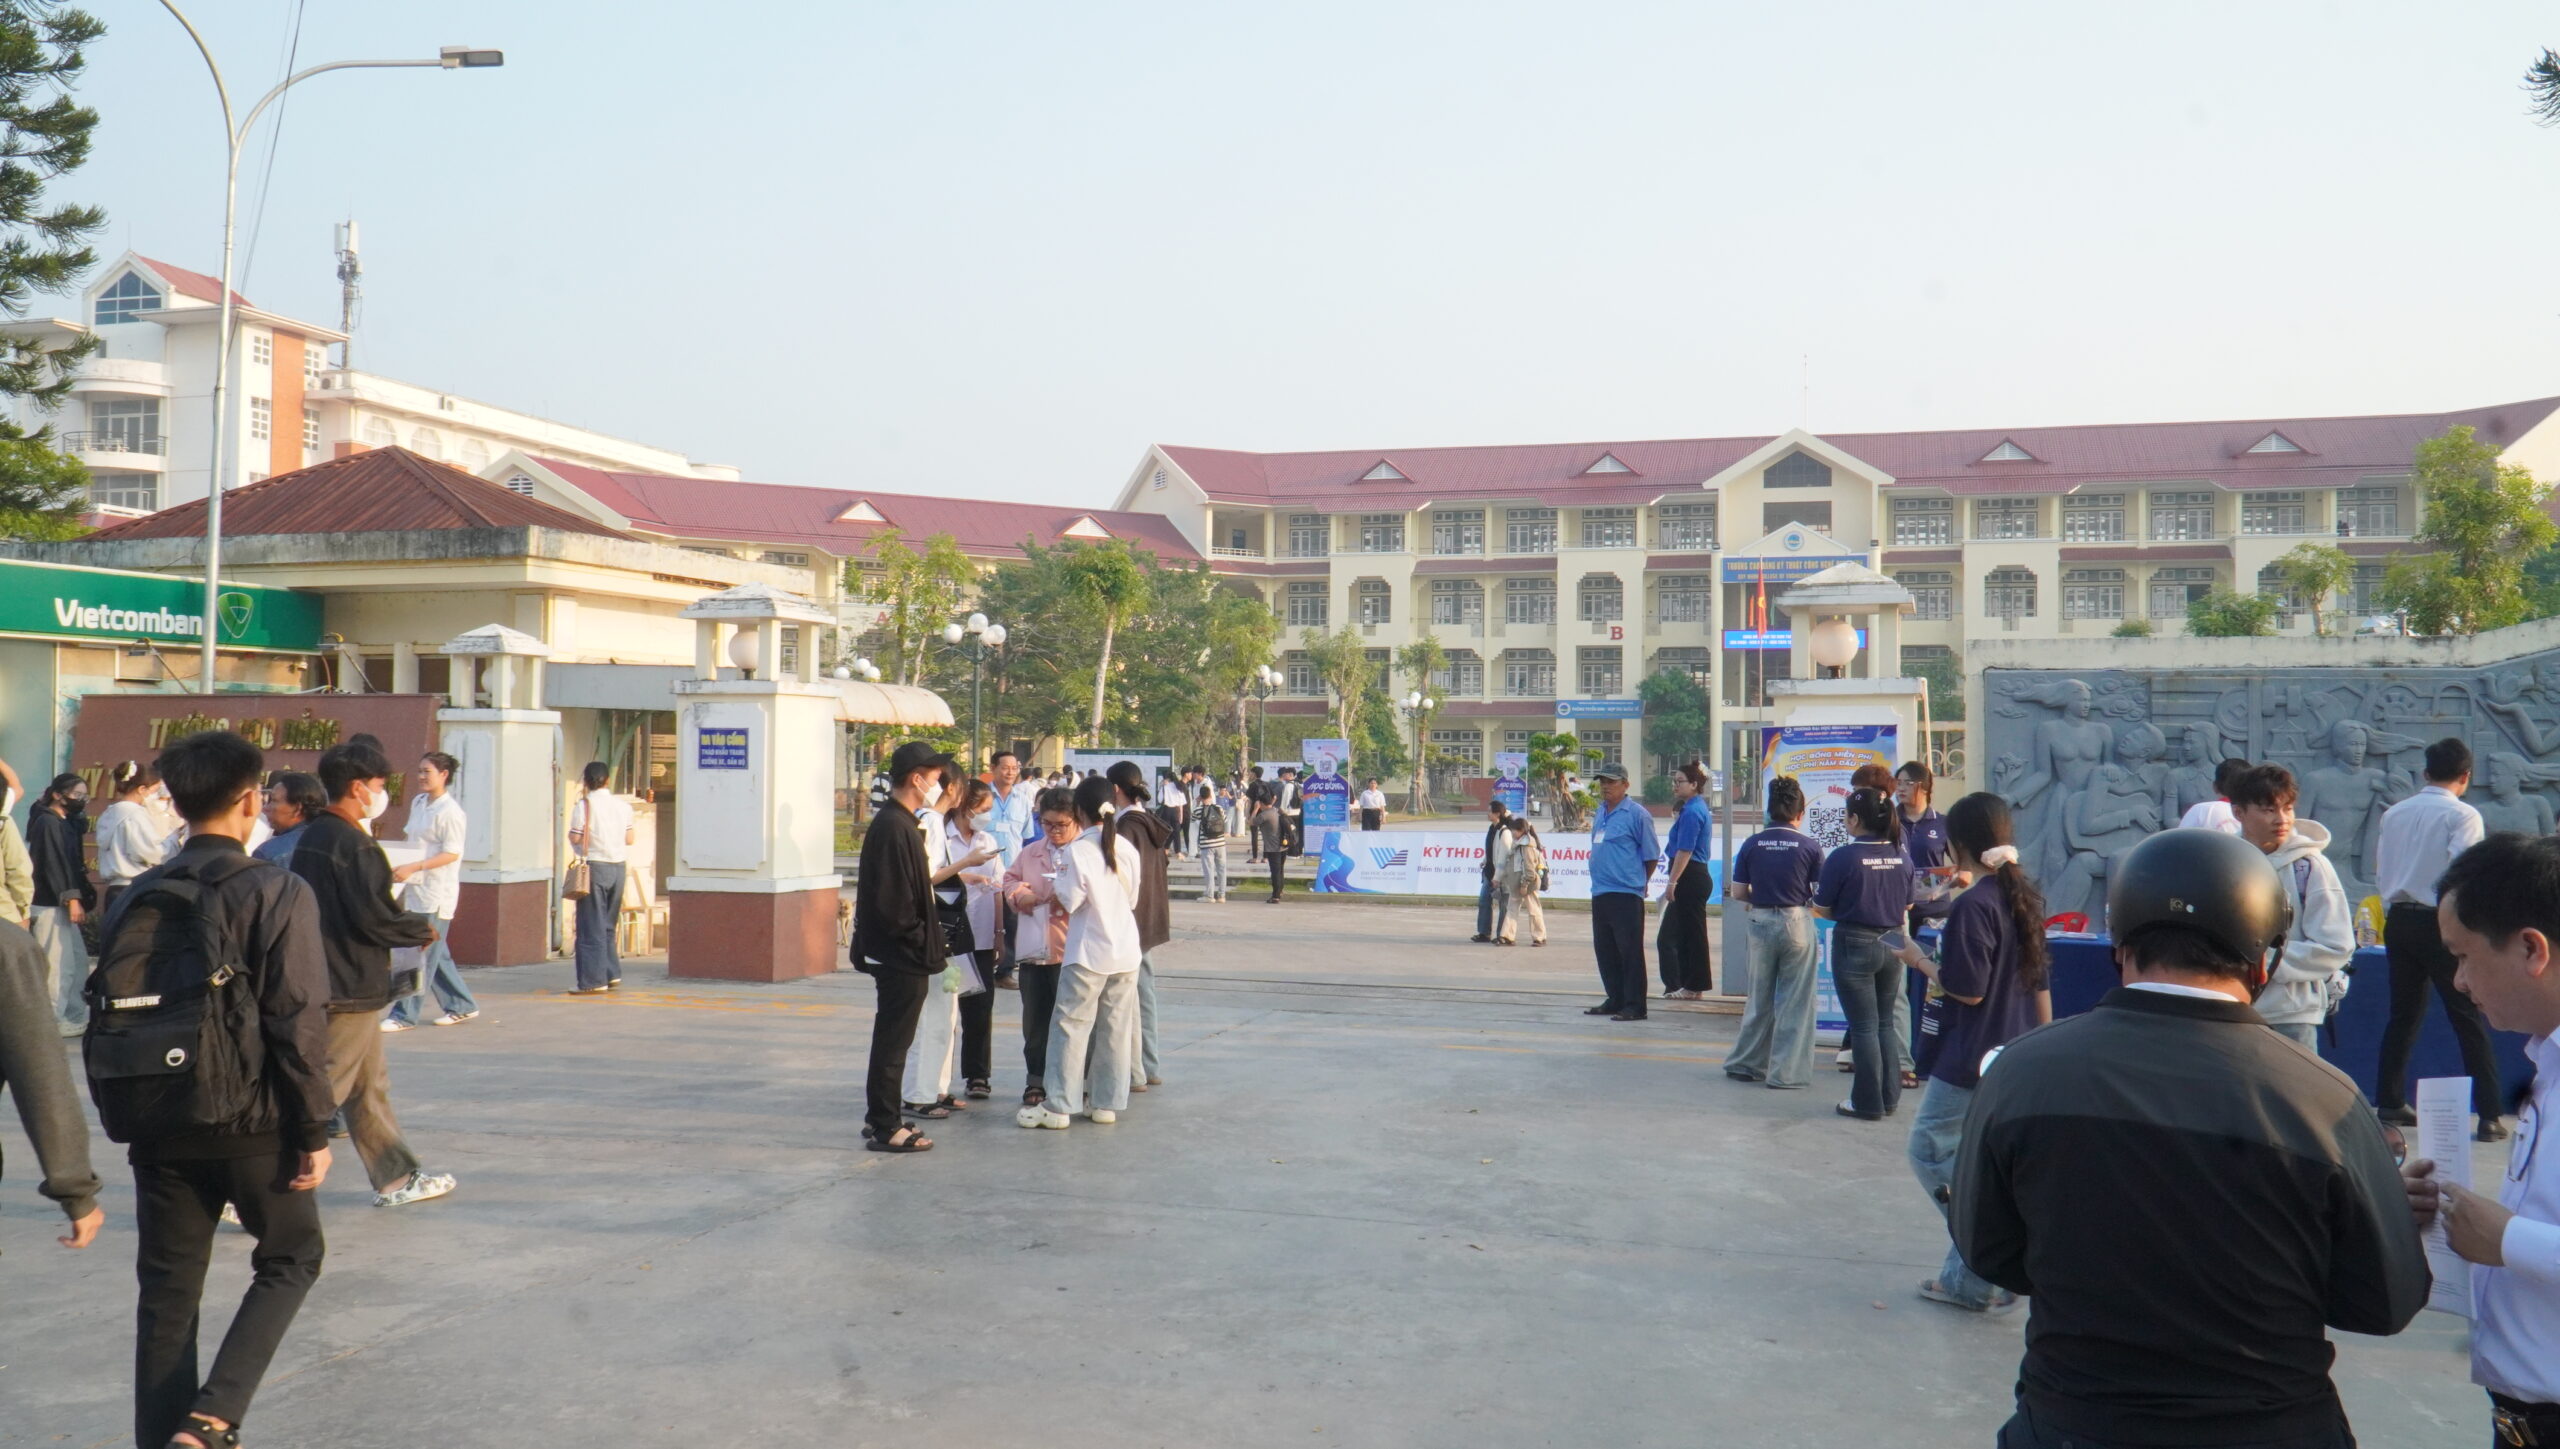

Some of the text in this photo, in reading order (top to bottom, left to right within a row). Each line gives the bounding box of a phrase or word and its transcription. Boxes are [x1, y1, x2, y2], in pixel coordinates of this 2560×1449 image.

[54, 597, 204, 636] Vietcomban
[1610, 626, 1624, 640] B
[1790, 754, 1806, 762] HỌC
[1857, 753, 1873, 761] PHÍ
[1785, 763, 1801, 771] HỌC
[1803, 760, 1817, 768] PHÍ
[1423, 845, 1443, 858] KỲ
[1446, 848, 1471, 858] THI
[1862, 857, 1903, 866] QUANG TRUNG
